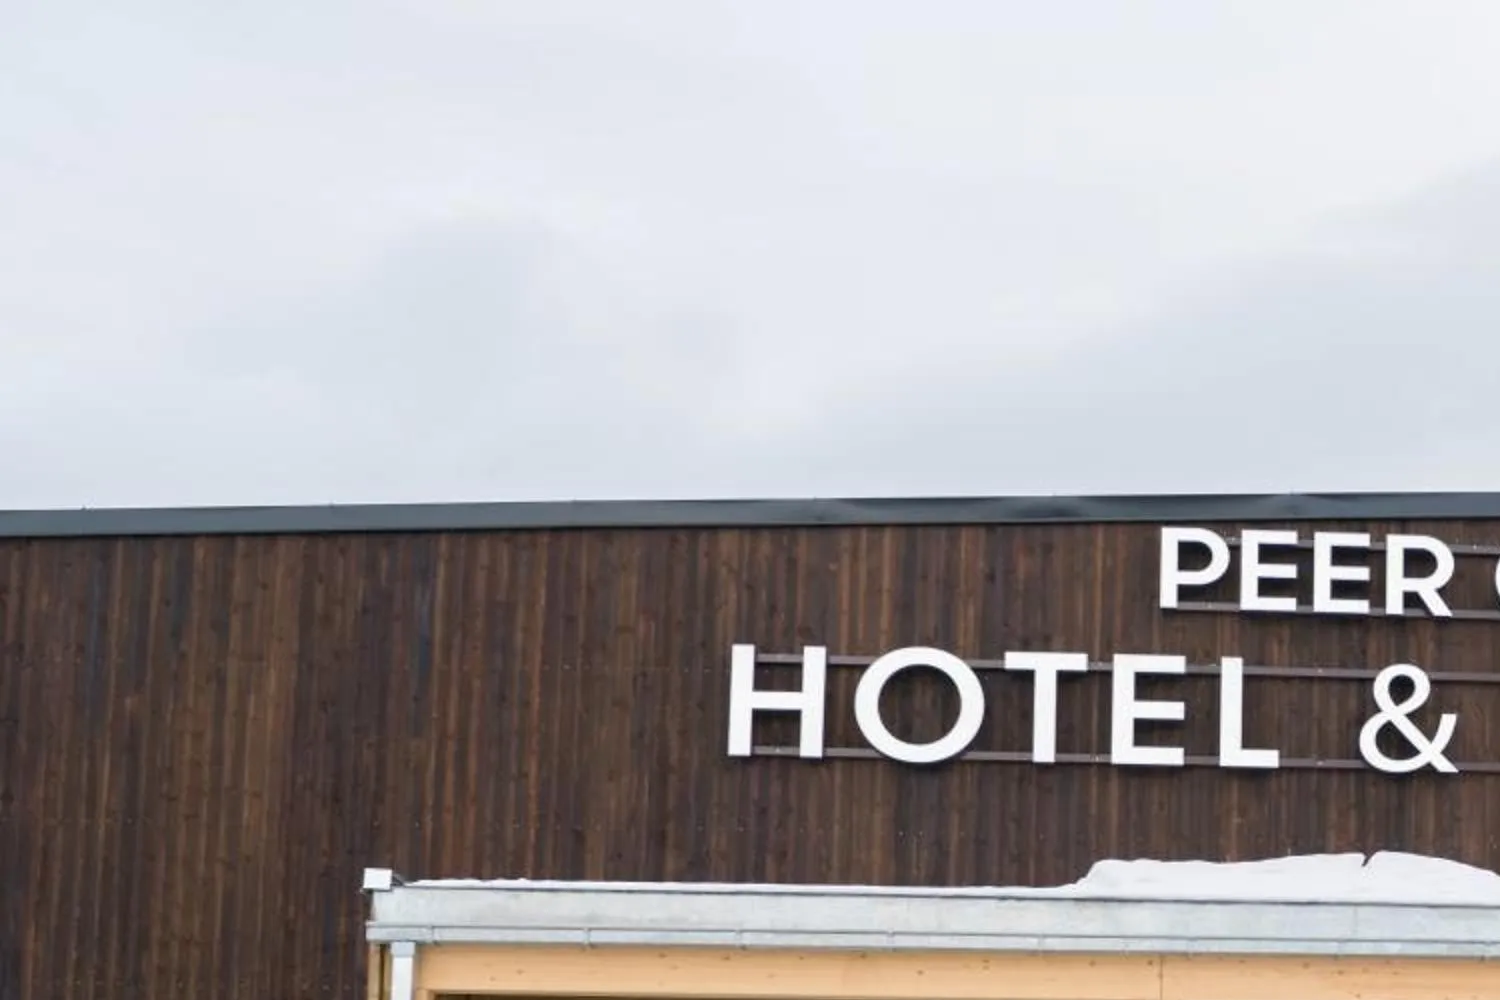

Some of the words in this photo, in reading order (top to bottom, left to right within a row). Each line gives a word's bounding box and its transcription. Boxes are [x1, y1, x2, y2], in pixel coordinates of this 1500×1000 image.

[1159, 526, 1455, 618] PEER
[727, 643, 1281, 769] HOTEL
[1358, 663, 1459, 774] &
